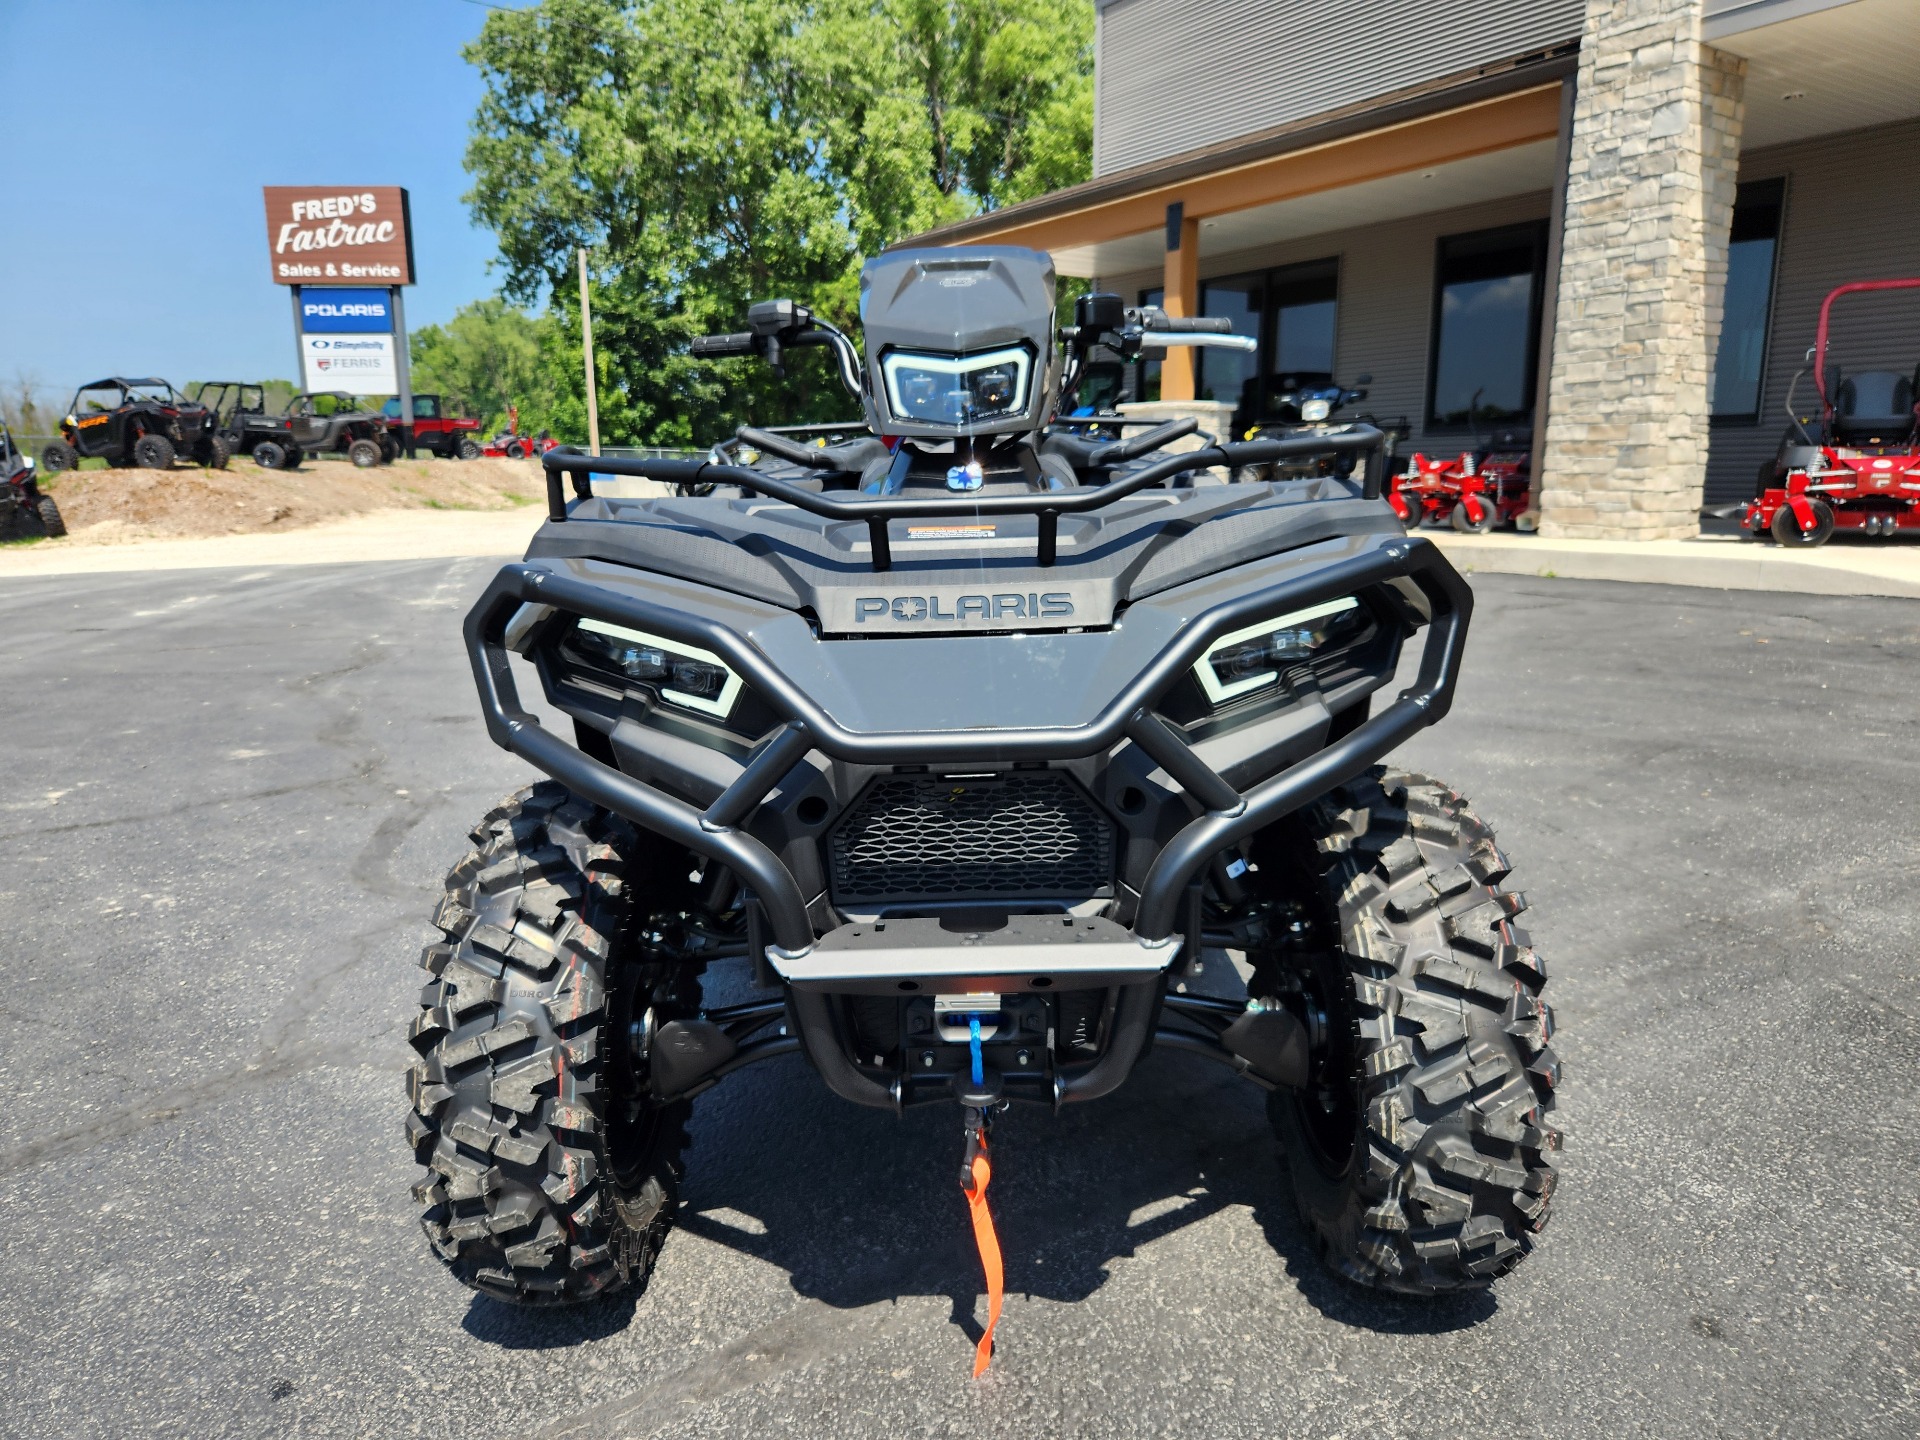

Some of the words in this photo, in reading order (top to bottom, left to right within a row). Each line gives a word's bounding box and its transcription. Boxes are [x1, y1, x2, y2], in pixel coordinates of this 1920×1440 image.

[292, 194, 376, 221] FRED'S
[276, 218, 396, 253] Fastrac
[279, 263, 321, 276] Sales
[325, 263, 338, 277] &
[342, 263, 400, 277] Service
[304, 304, 385, 316] POLARIS
[333, 341, 384, 350] Simplicity
[333, 359, 380, 368] FERRIS
[855, 592, 1075, 623] POLARIS
[510, 988, 545, 999] DURO
